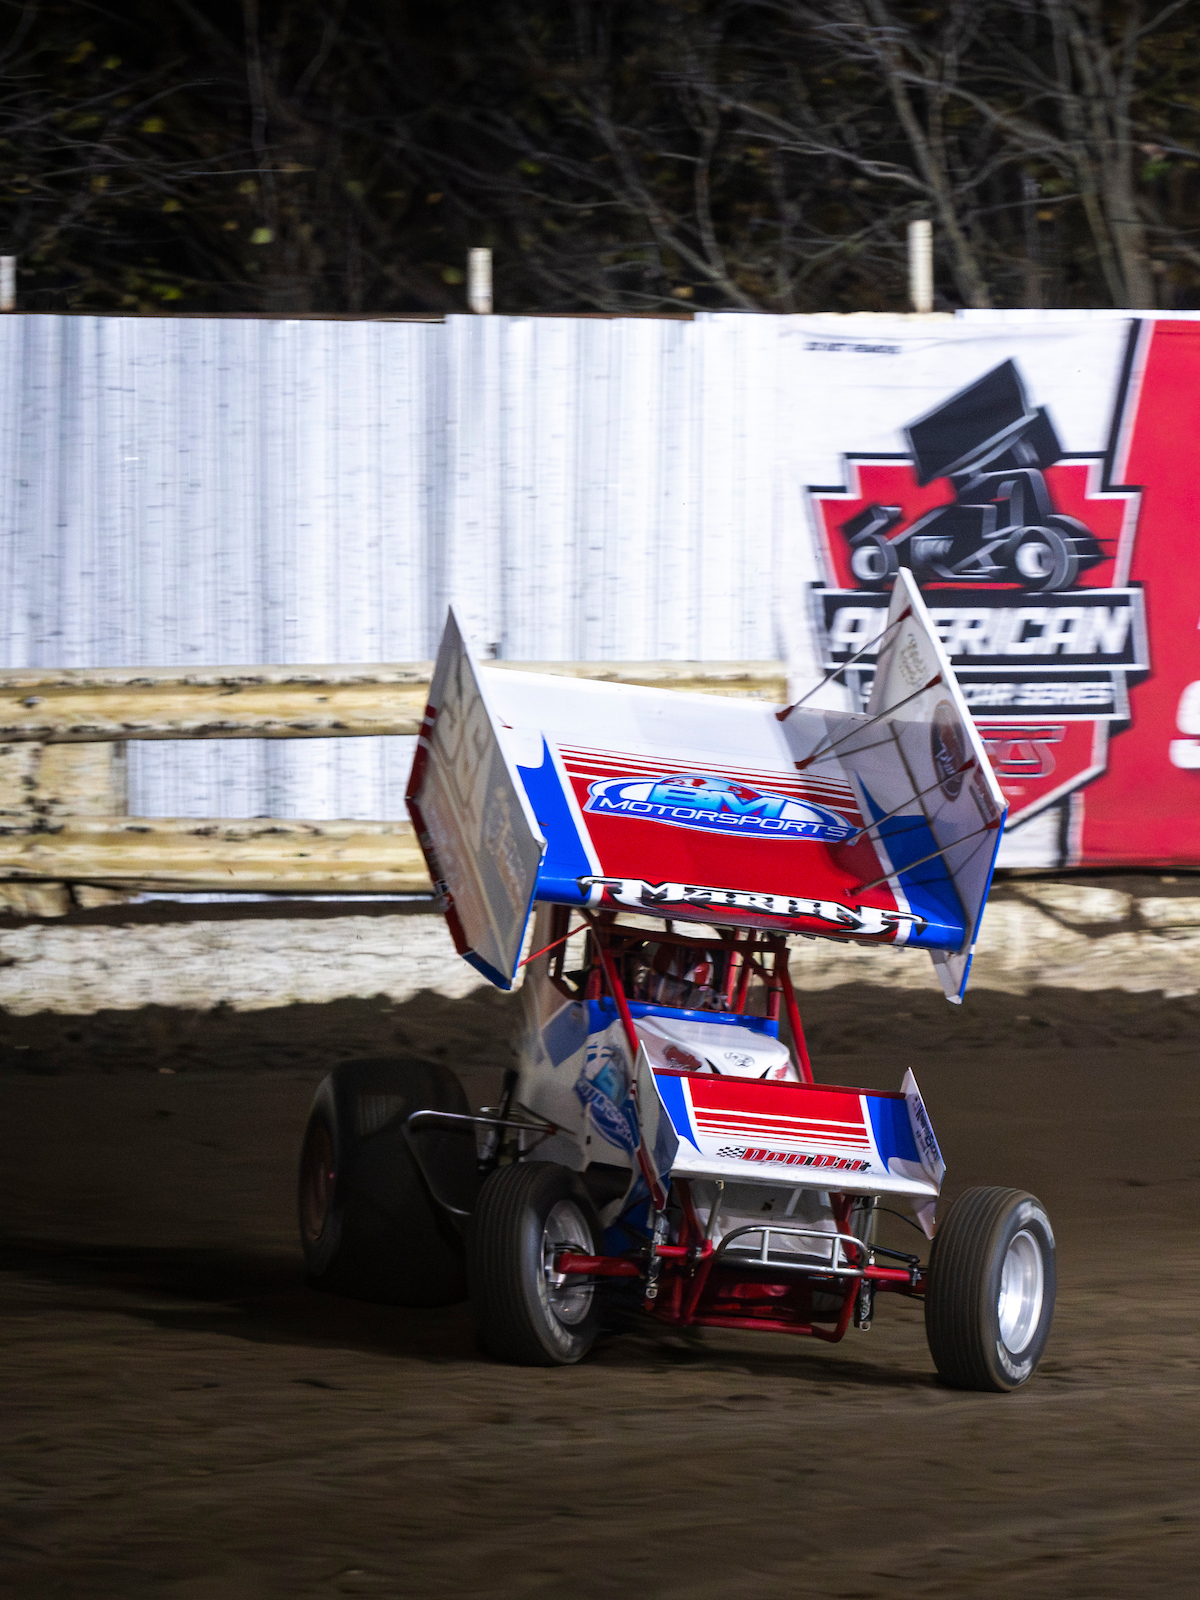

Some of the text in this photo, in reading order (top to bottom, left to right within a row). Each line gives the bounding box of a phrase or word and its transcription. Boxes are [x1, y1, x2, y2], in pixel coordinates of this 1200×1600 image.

[829, 606, 1131, 655] AERICAN
[599, 797, 850, 838] MOTORSPORTS
[647, 781, 787, 818] BM
[577, 875, 926, 936] MARTIN
